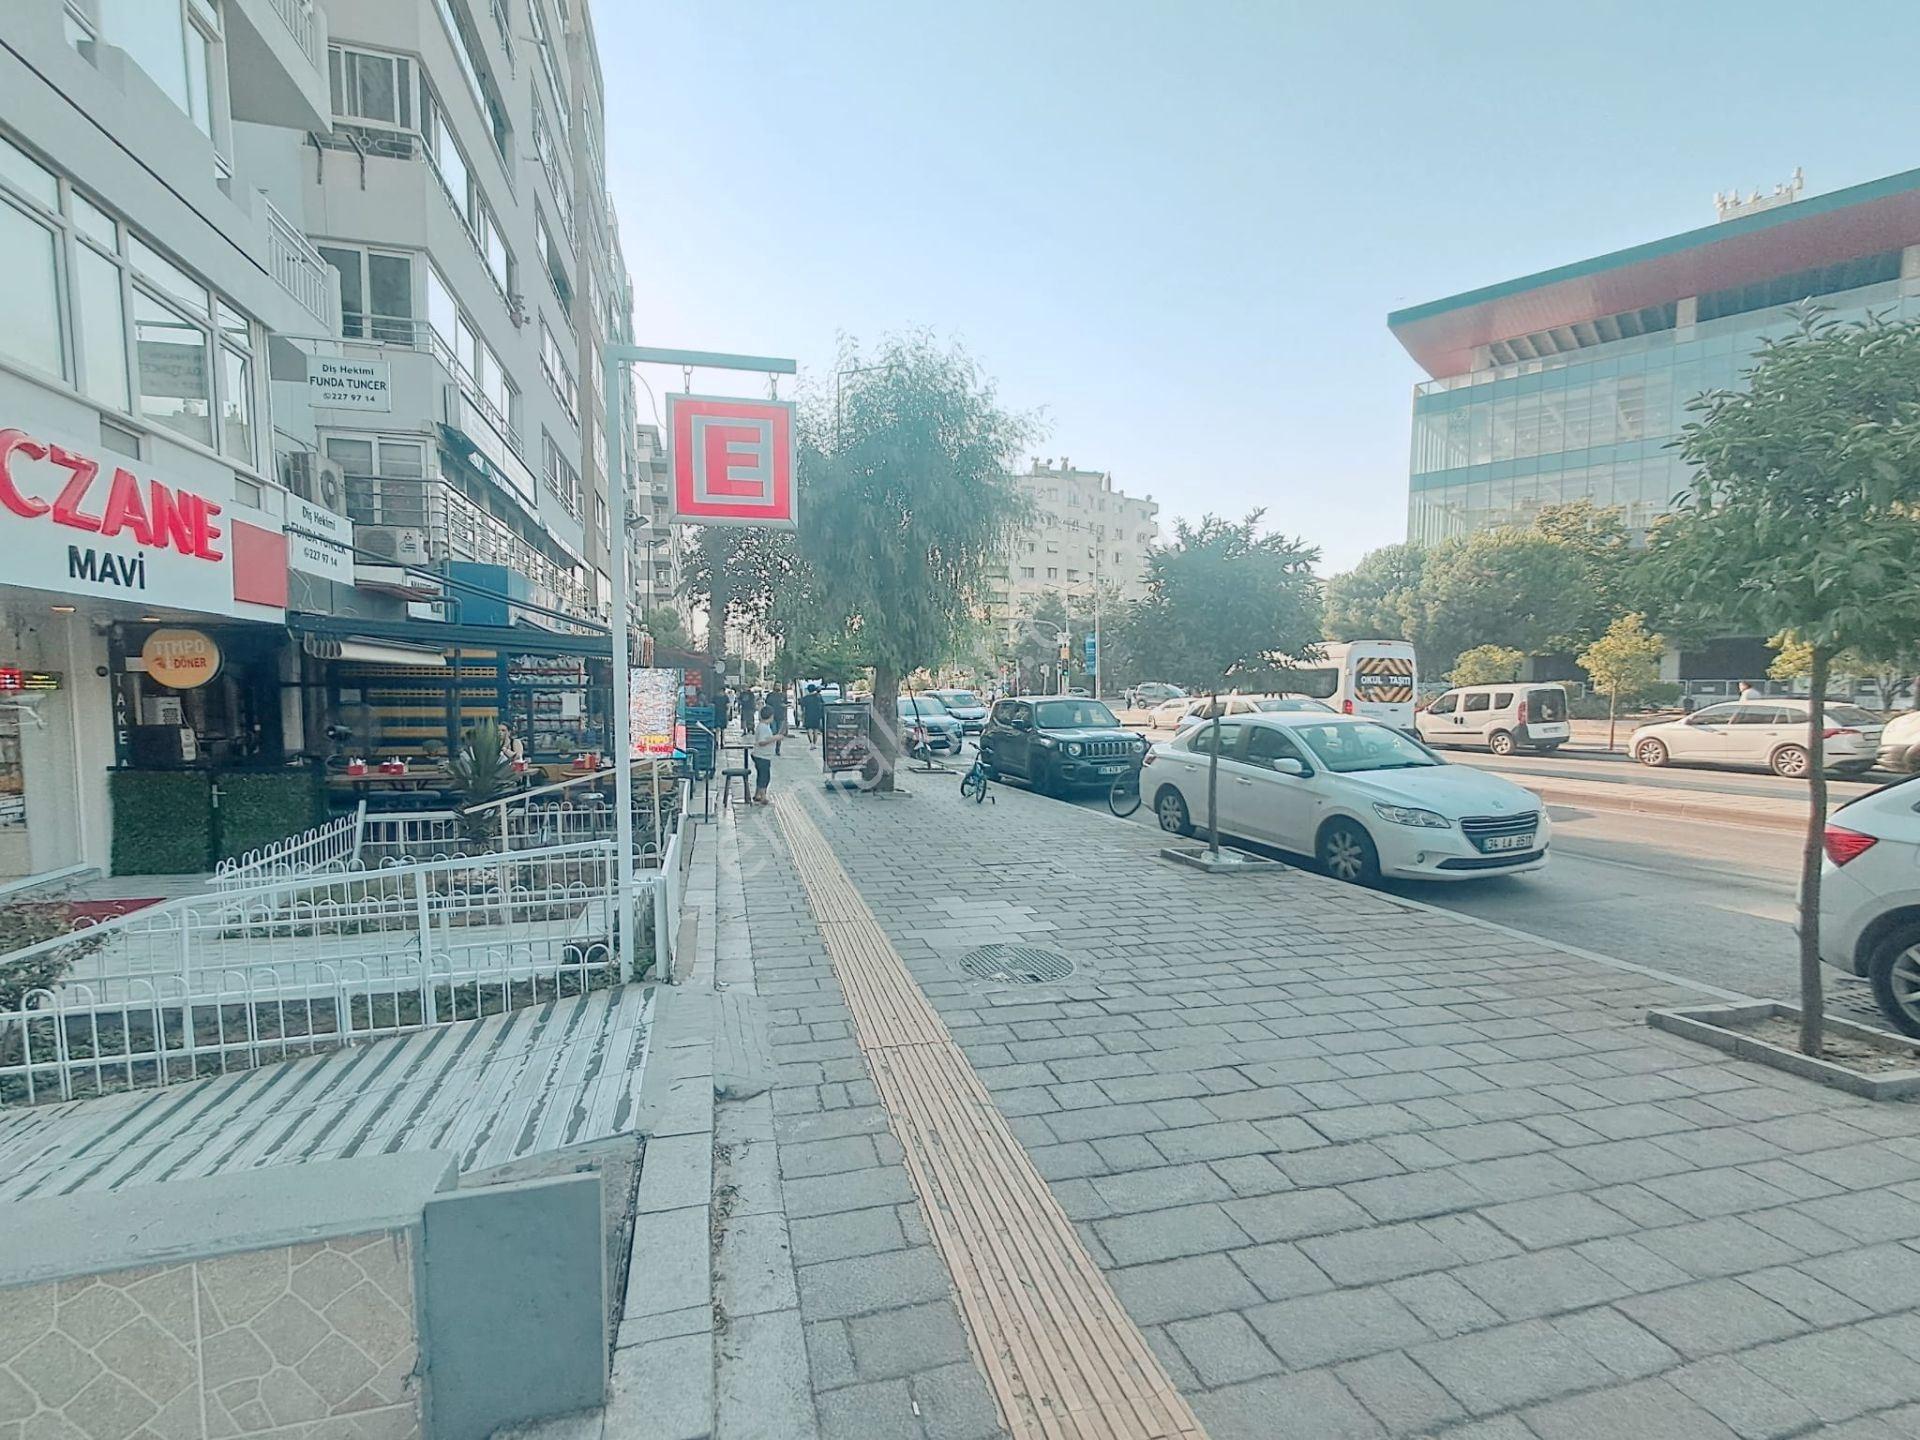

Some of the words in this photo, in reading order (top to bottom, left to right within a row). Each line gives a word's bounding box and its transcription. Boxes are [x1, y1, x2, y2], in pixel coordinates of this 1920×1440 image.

[340, 365, 374, 376] Hekimi
[309, 376, 345, 388] FUNDA
[346, 379, 387, 391] TUNCER
[705, 424, 764, 497] E
[313, 511, 336, 531] Hekimi
[174, 656, 207, 669] DÖNER
[1361, 675, 1383, 685] OKUL
